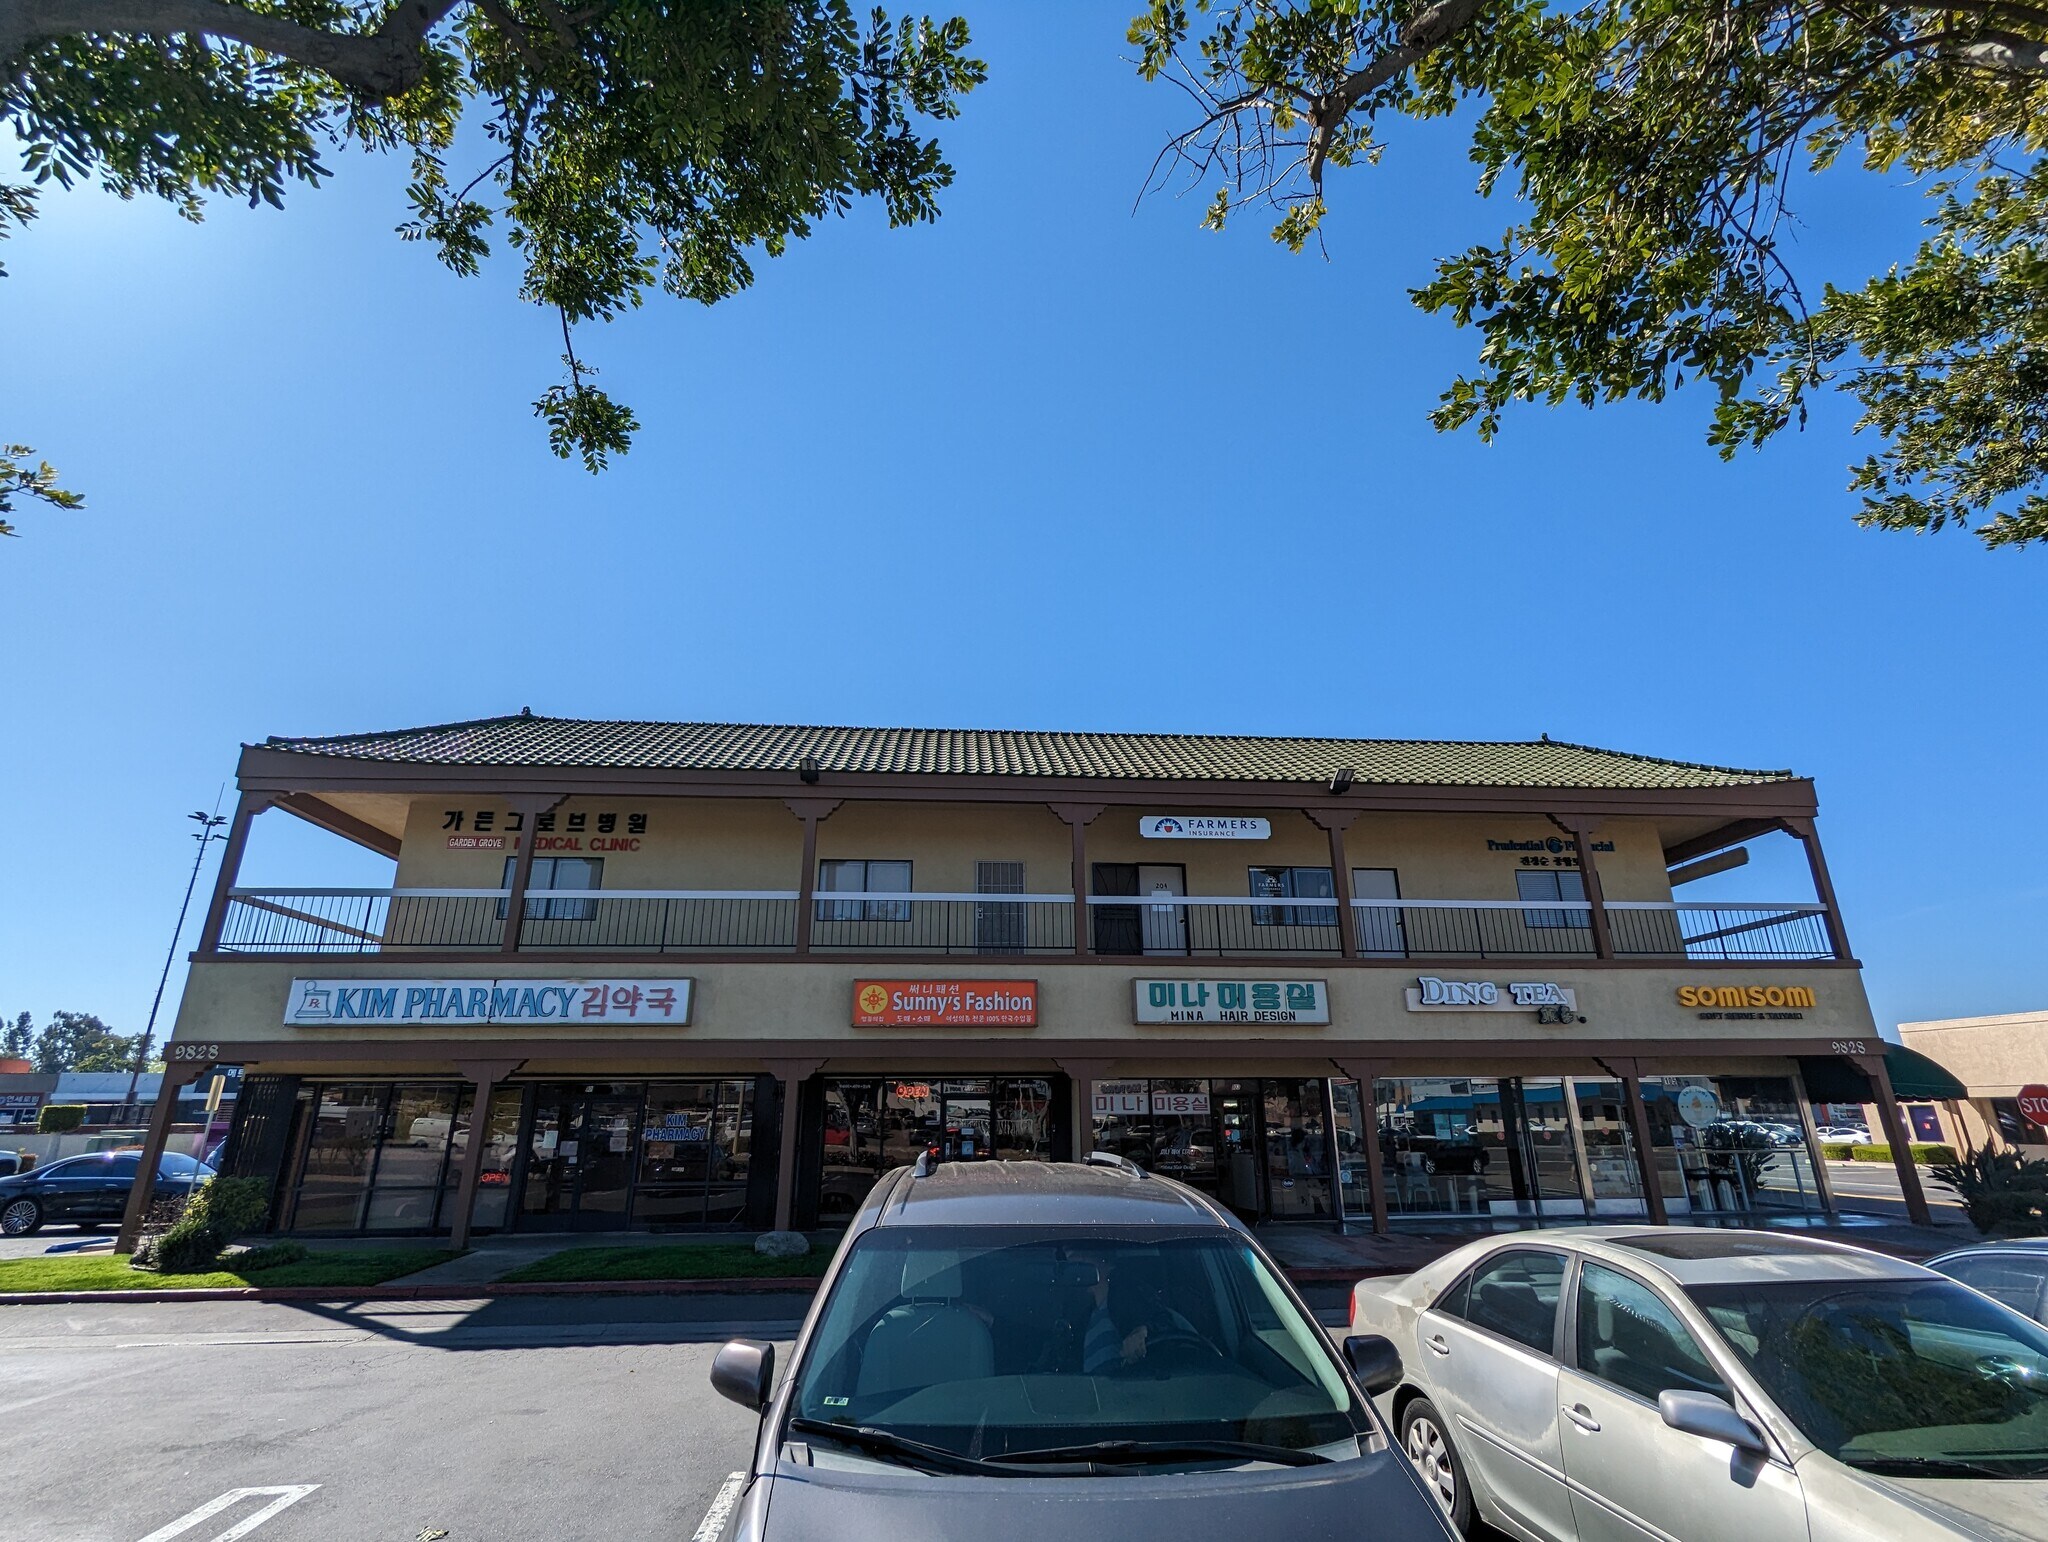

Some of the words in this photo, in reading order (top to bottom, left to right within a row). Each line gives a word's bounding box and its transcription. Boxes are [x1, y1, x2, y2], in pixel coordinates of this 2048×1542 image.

[1188, 819, 1257, 830] FARMERS
[449, 838, 477, 847] GARDEN
[478, 838, 503, 848] GROVE
[589, 837, 641, 851] CLINIC
[1487, 839, 1546, 851] Prudential
[909, 983, 960, 995] 써니패션
[1418, 977, 1499, 1005] DING
[1509, 983, 1568, 1005] TEA
[333, 987, 399, 1018] KIM
[402, 986, 579, 1018] PHARMACY
[581, 984, 677, 1018] 김약국
[892, 991, 962, 1016] Sunny's
[965, 991, 1033, 1011] Fashion
[1149, 983, 1210, 1008] 미나
[1217, 983, 1316, 1010] 미용실
[1170, 1011, 1204, 1021] MINA
[1220, 1011, 1248, 1021] HAIR
[1254, 1011, 1296, 1021] DESIGN
[175, 1044, 219, 1060] 9828
[1832, 1041, 1866, 1055] 9828
[896, 1085, 929, 1098] OPEN
[1095, 1095, 1144, 1112] 미나
[1154, 1096, 1208, 1112] 미용실
[2021, 1097, 2048, 1113] STO
[666, 1113, 688, 1127] KIM
[644, 1128, 706, 1141] PHARMACY
[481, 1172, 511, 1184] OPEN
